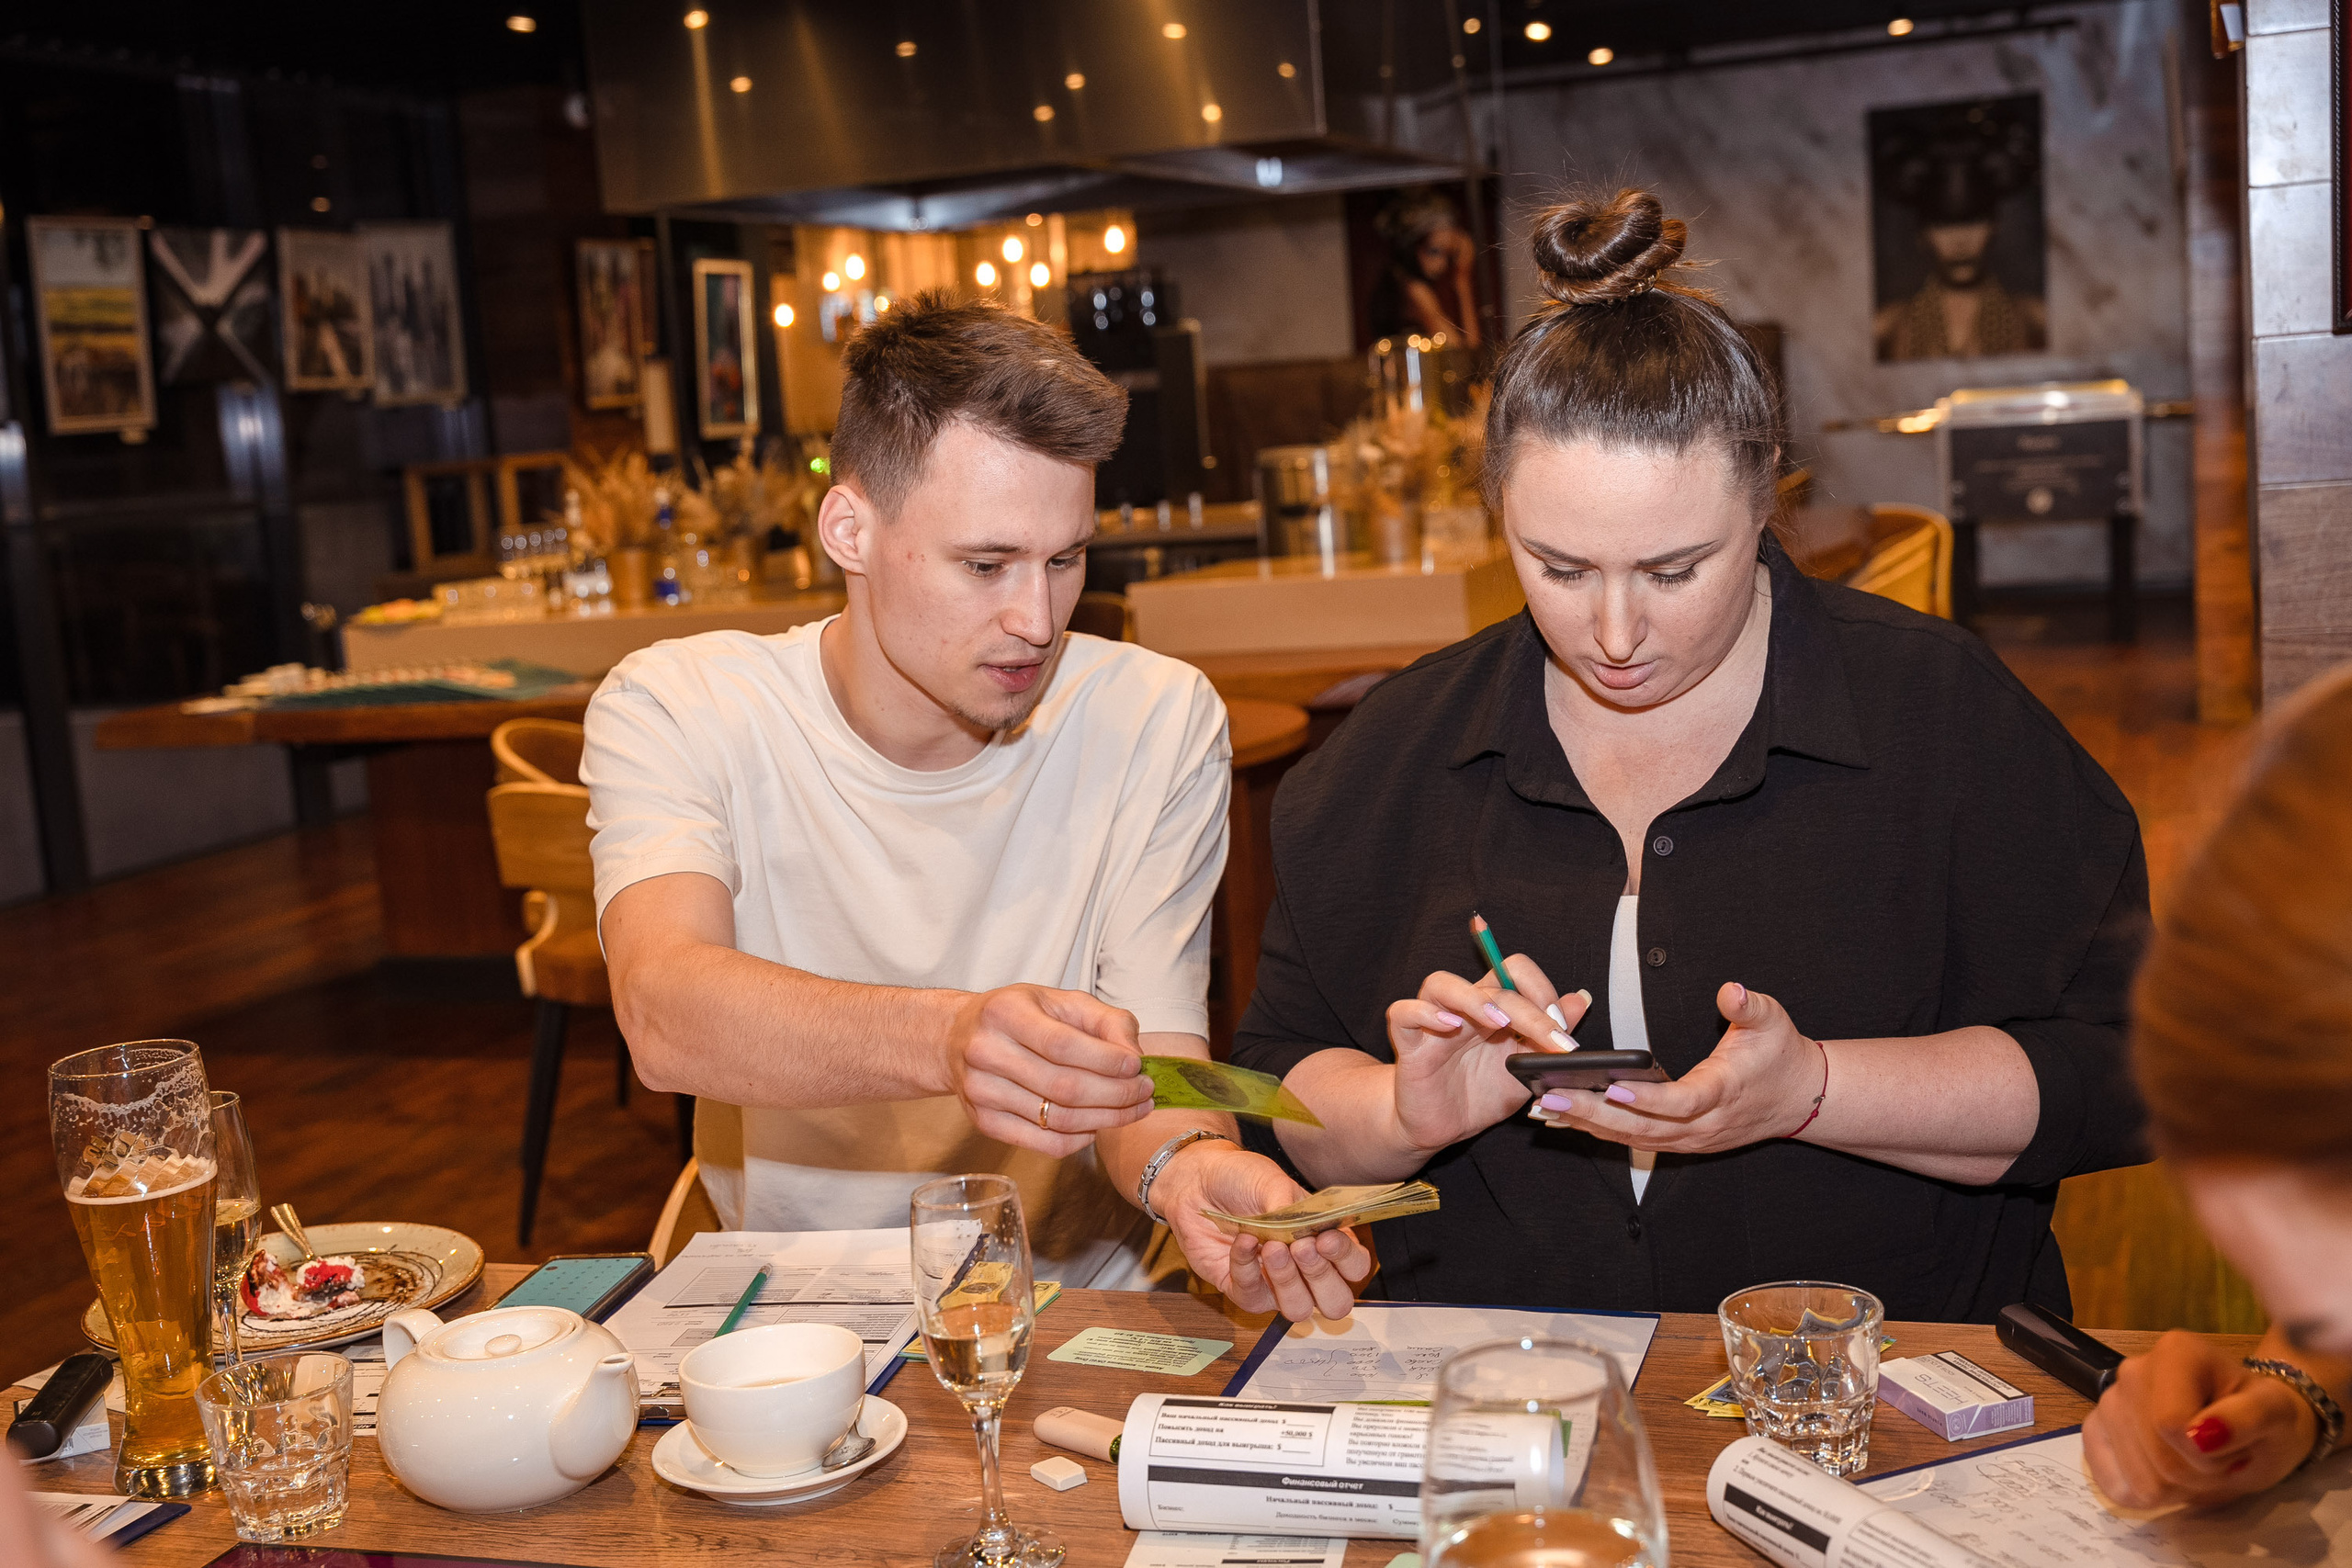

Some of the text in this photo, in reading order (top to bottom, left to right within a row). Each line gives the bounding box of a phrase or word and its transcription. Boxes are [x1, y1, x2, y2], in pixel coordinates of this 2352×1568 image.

[1915, 1373, 1969, 1404] HEETS
[1155, 1437, 1195, 1445] Пассивный
[1282, 1477, 1338, 1487] Финансовый
[1266, 1495, 1309, 1504] Начальный
